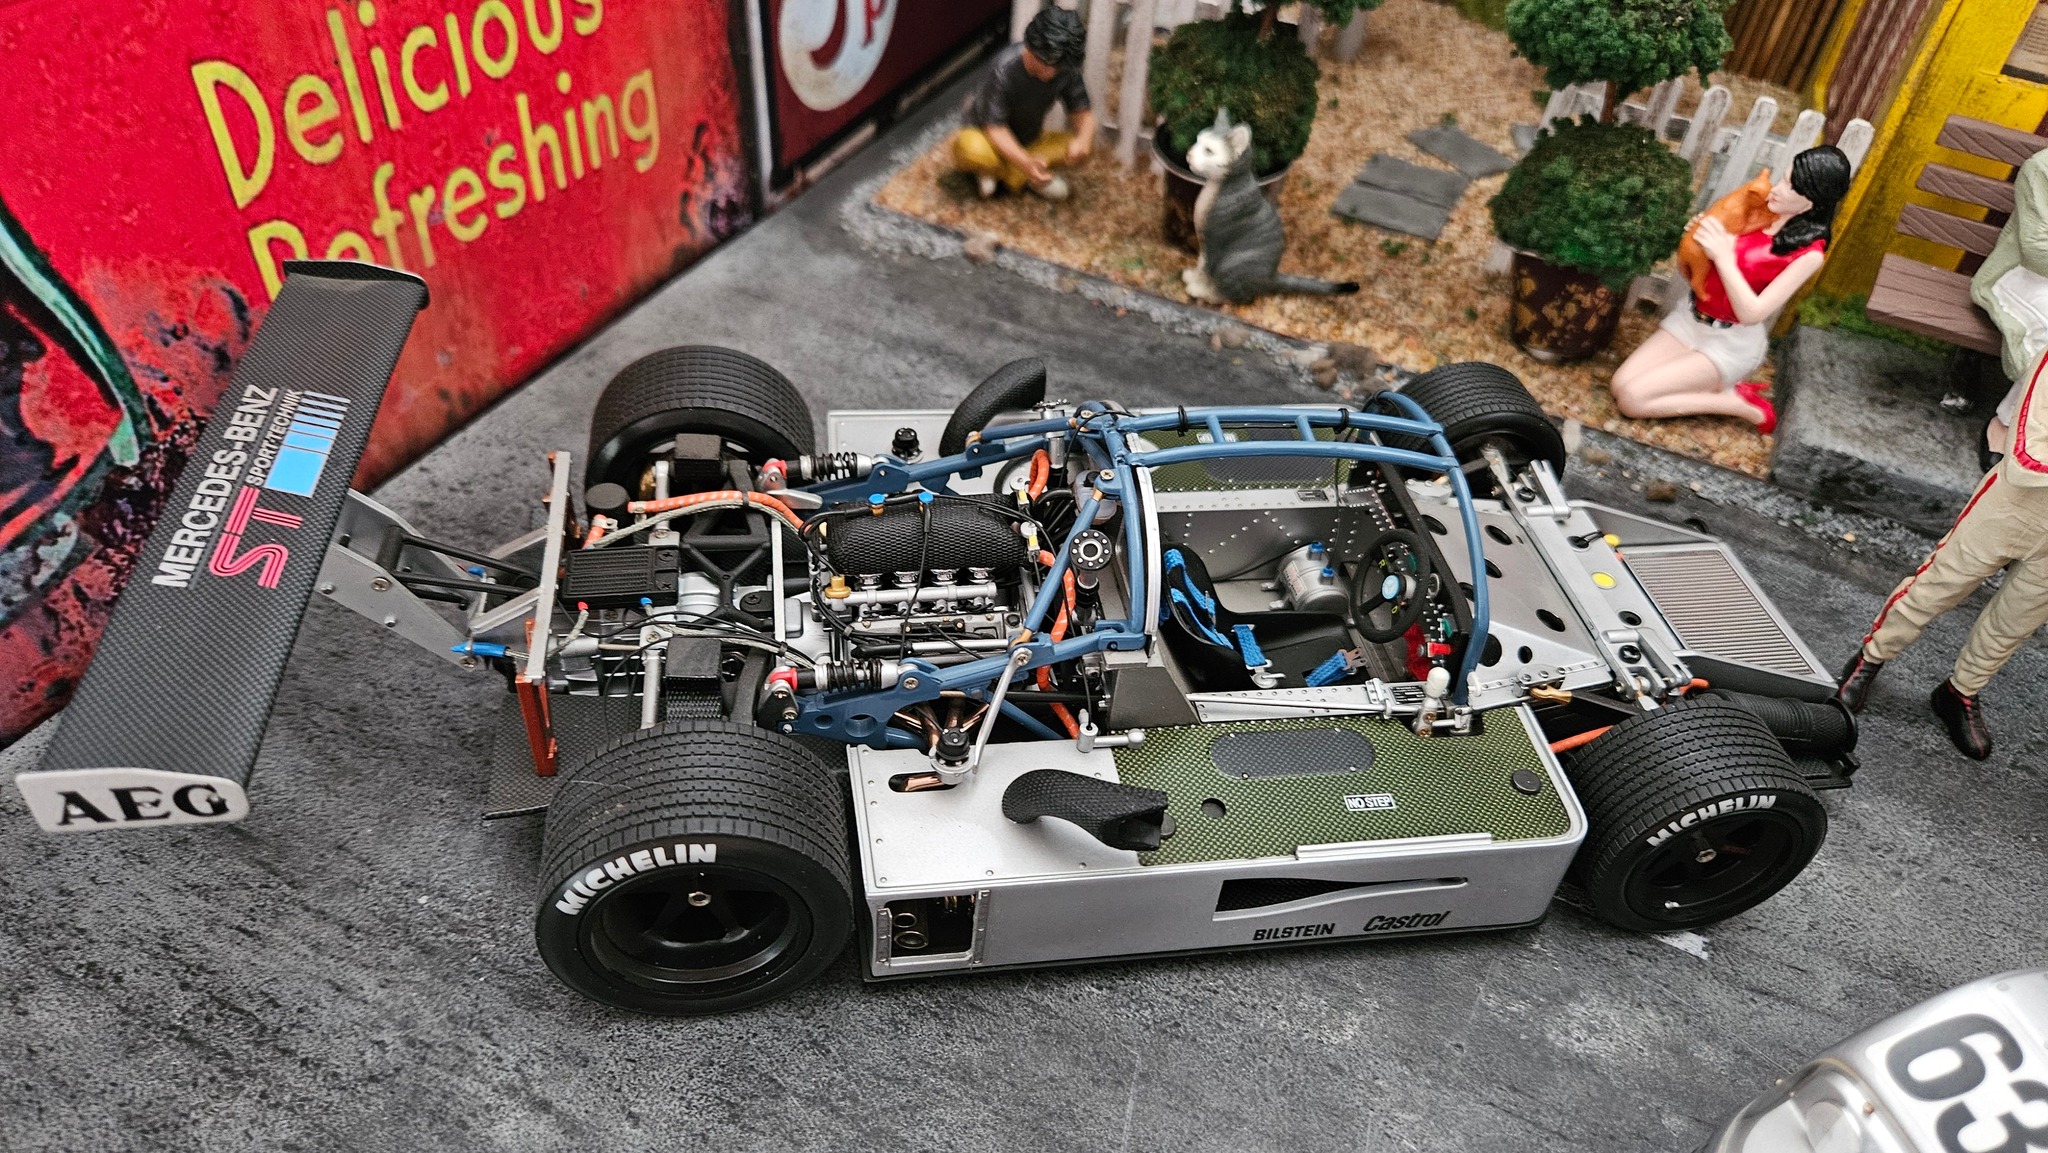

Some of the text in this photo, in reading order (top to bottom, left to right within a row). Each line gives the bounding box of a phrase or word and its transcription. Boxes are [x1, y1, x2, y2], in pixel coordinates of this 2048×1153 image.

[151, 384, 279, 588] MERCEDES-BENZ
[208, 484, 304, 589] ST
[56, 783, 230, 826] AEG
[1347, 796, 1390, 809] NO STEP
[1646, 795, 1776, 848] MICHELIN
[555, 843, 717, 916] MICHELIN
[1253, 923, 1336, 941] BILSTEIN
[1363, 911, 1450, 932] Castrol
[1886, 1013, 2048, 1153] 63
